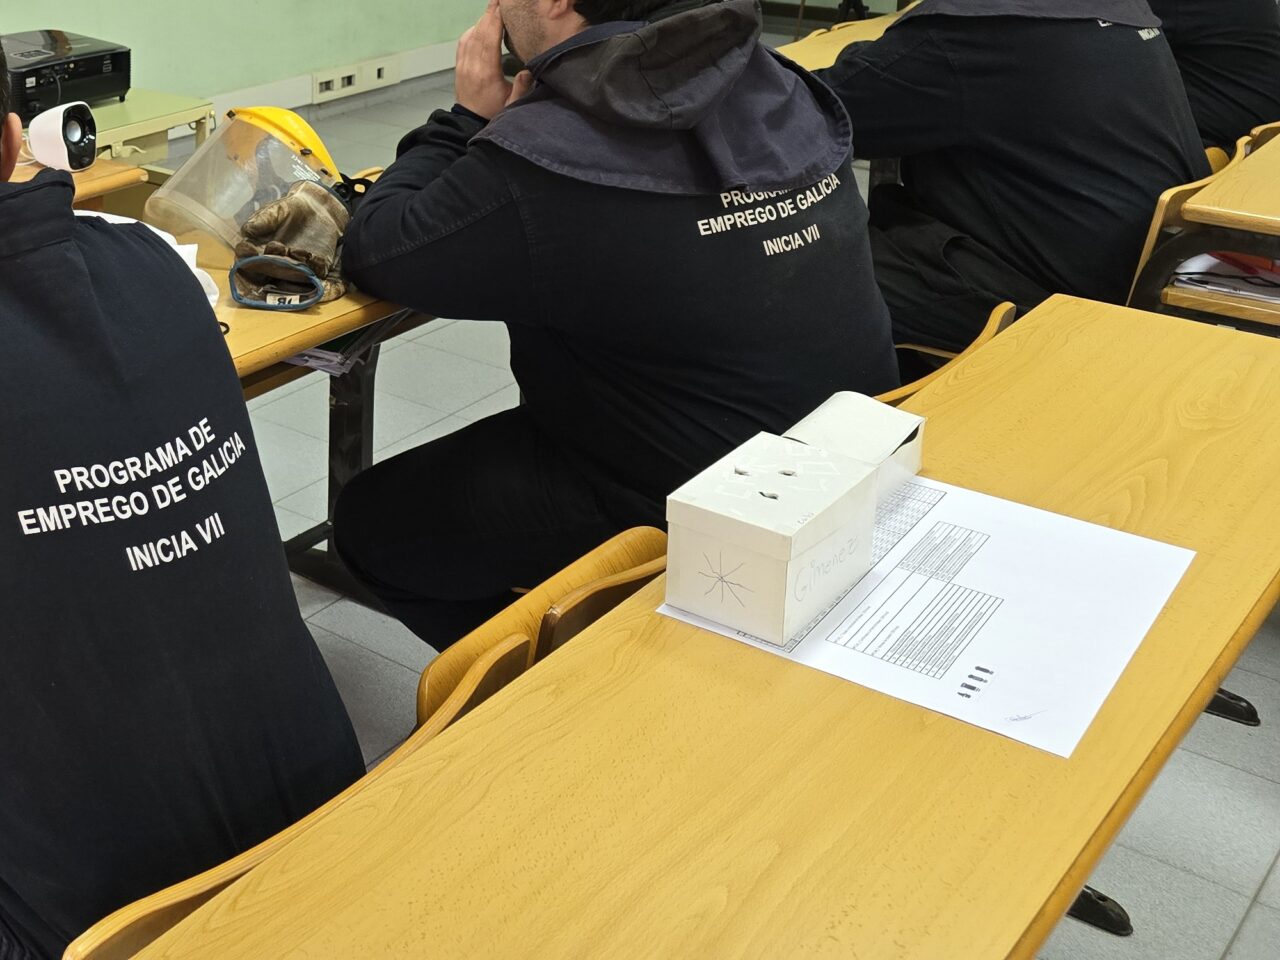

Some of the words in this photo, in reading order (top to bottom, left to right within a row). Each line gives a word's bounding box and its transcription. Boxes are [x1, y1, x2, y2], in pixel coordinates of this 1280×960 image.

[697, 205, 777, 236] EMPREGO
[776, 198, 797, 219] DE
[796, 173, 841, 210] GALICIA
[762, 232, 805, 256] INICIA
[801, 223, 821, 244] VII
[17, 491, 150, 535] EMPREGO
[151, 476, 188, 510] DE
[187, 431, 247, 491] GALICIA
[53, 436, 193, 494] PROGRAMA
[188, 417, 216, 452] DE
[125, 529, 199, 572] INICIA
[195, 512, 226, 545] VII
